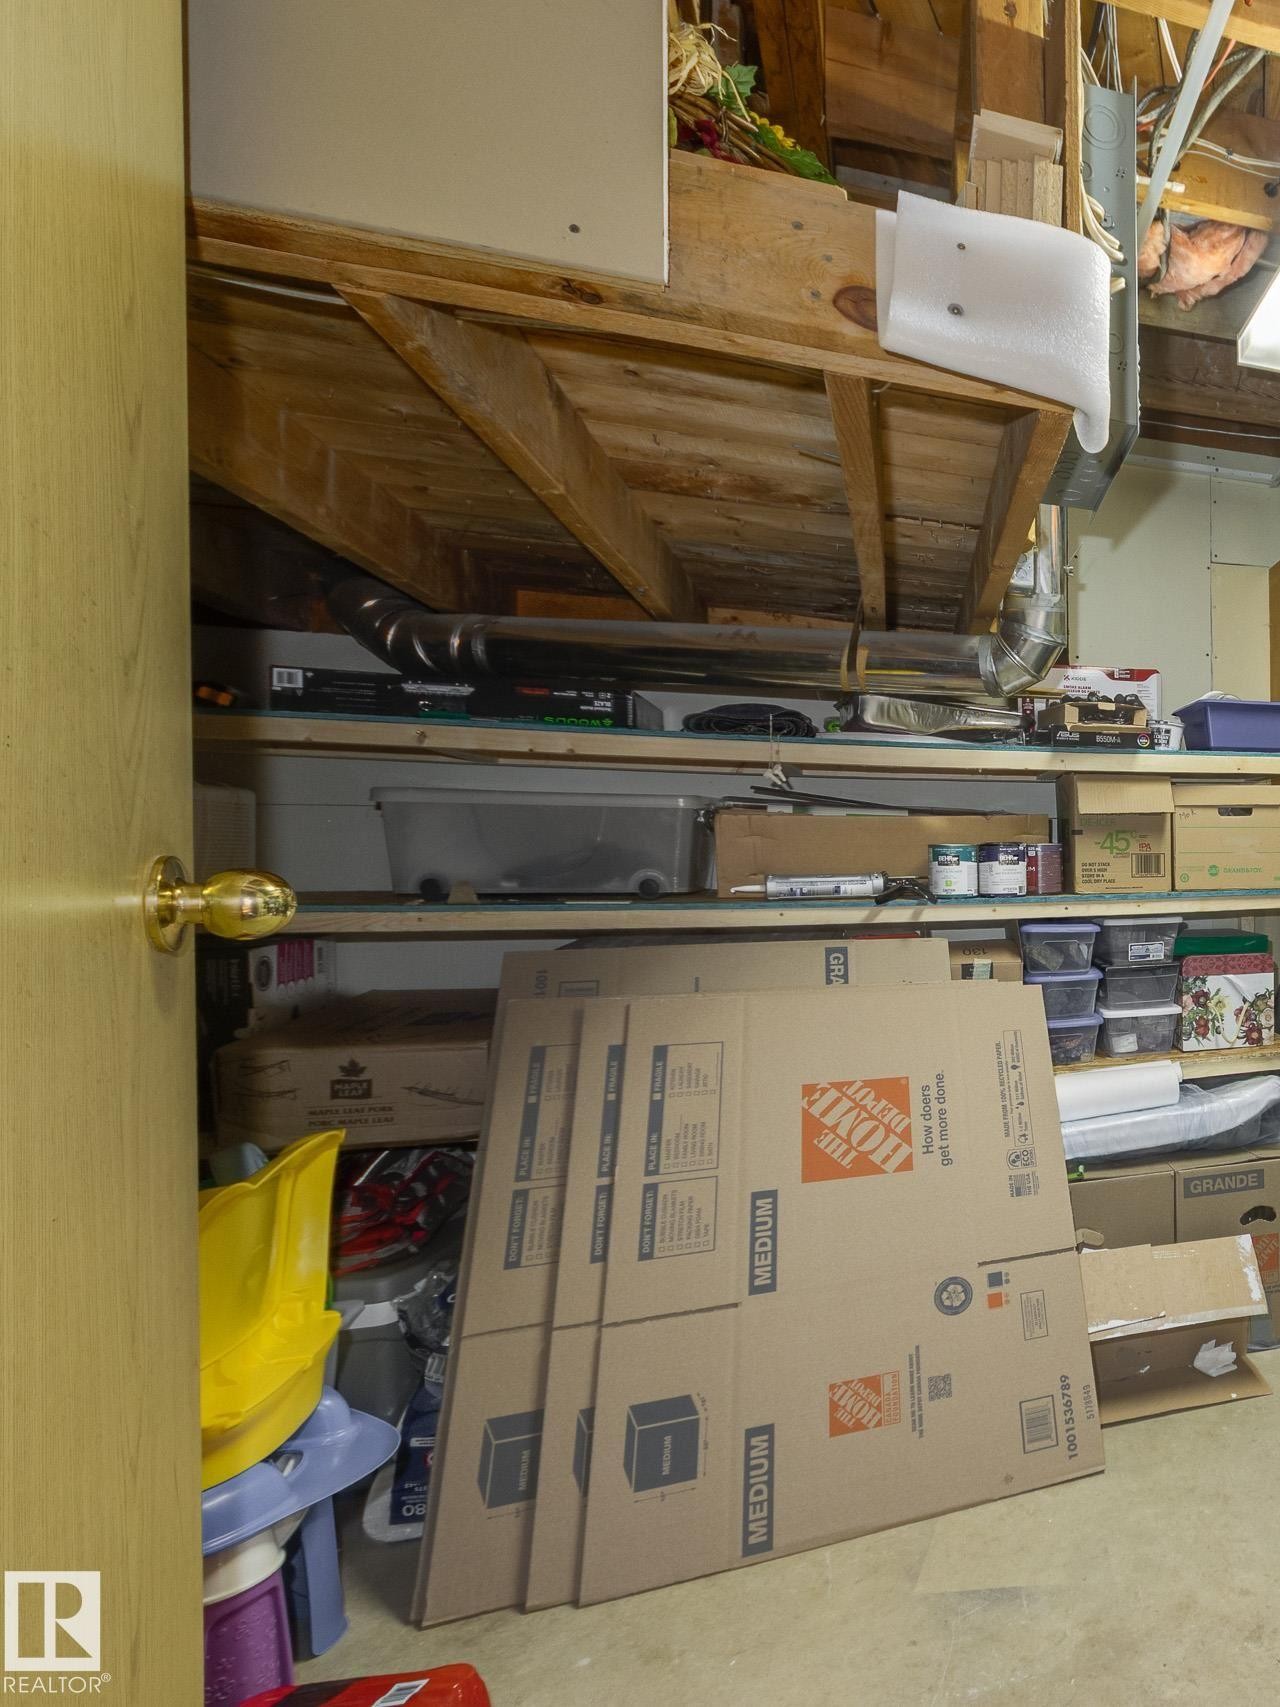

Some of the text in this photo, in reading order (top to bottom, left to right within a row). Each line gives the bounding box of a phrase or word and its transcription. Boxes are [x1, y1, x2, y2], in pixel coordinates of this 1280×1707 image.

[654, 1061, 664, 1092] FRAGILE
[801, 1082, 912, 1174] HOME
[843, 1080, 911, 1136] DEPOT
[922, 1084, 934, 1155] How doers
[935, 1070, 953, 1166] get more done.
[648, 1145, 657, 1170] PLACE
[814, 1129, 859, 1168] THE
[1190, 1173, 1259, 1194] GRANDE
[753, 1198, 773, 1287] MEDIUM
[829, 1381, 882, 1428] HOME
[850, 1379, 882, 1407] DEPOT
[833, 1409, 856, 1428] THE
[1060, 1375, 1078, 1460] 1001536789
[518, 1449, 531, 1491] MEDIUM
[662, 1435, 672, 1476] MEDIUM
[748, 1434, 769, 1545] MEDIUM
